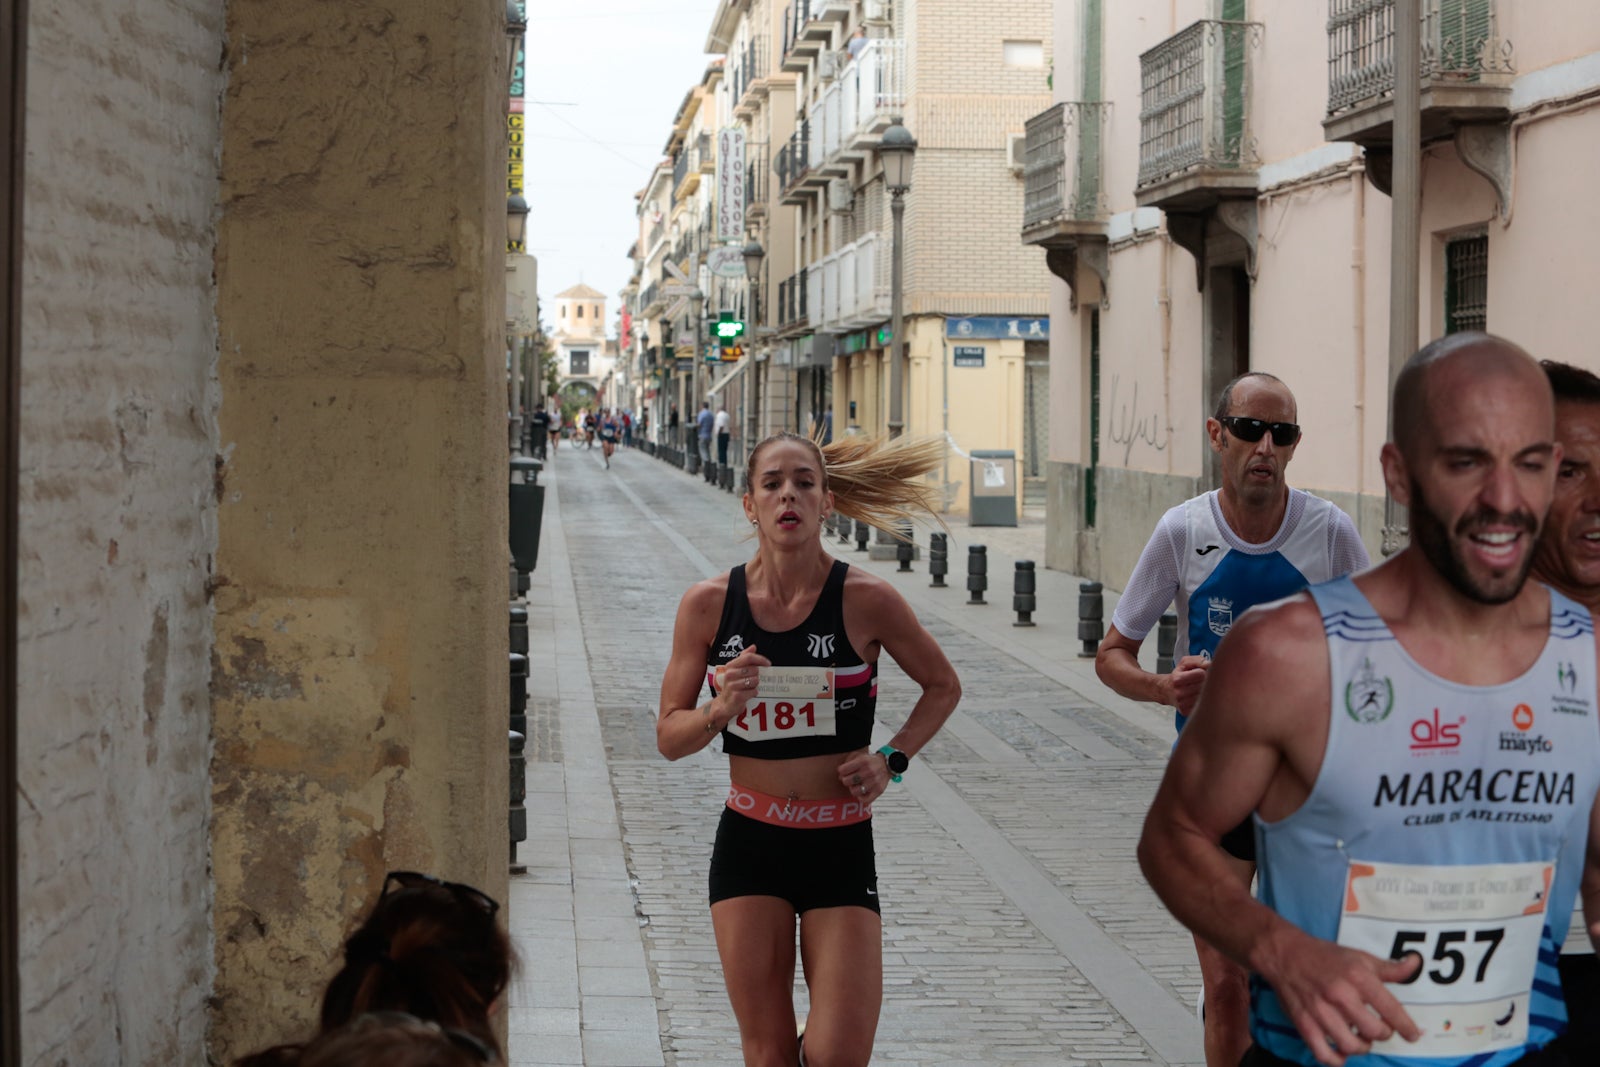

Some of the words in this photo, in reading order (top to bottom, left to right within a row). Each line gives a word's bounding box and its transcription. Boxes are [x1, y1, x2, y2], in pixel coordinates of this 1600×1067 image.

[733, 133, 743, 236] PIONONOS
[759, 675, 777, 684] REMIO
[1409, 707, 1462, 749] als
[1498, 735, 1553, 756] mayfo
[728, 787, 756, 810] RO
[765, 802, 836, 823] NIKE
[840, 800, 872, 821] PR
[1373, 768, 1576, 808] MARACENA
[1403, 813, 1445, 827] CLUB
[1465, 809, 1554, 824] ATLETISMO
[1388, 927, 1506, 985] 557
